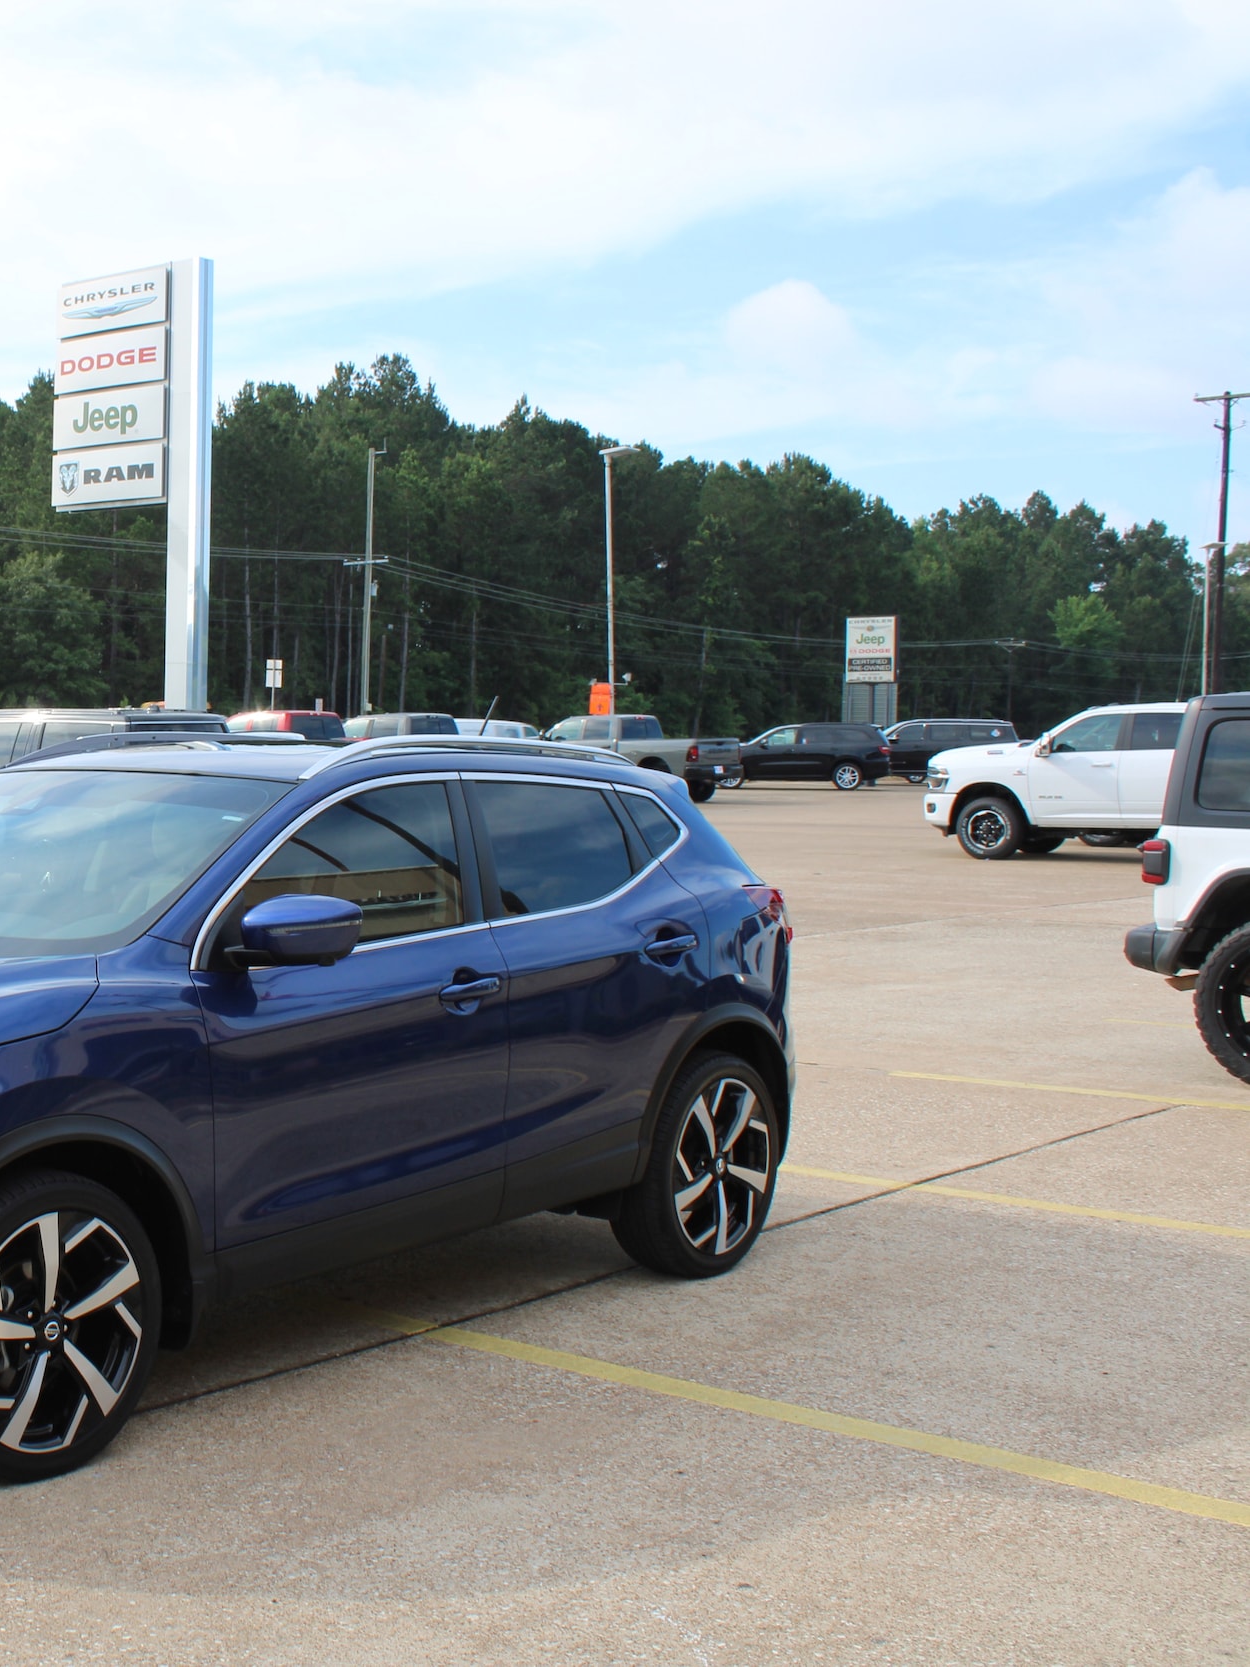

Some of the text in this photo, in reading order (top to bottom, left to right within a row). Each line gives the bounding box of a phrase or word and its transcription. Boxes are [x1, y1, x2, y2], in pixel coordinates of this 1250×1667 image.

[63, 281, 156, 308] CHRYSLER
[60, 346, 158, 376] DODGE
[73, 401, 138, 435] Jeep
[83, 463, 155, 486] RAM
[855, 633, 886, 646] Jeep
